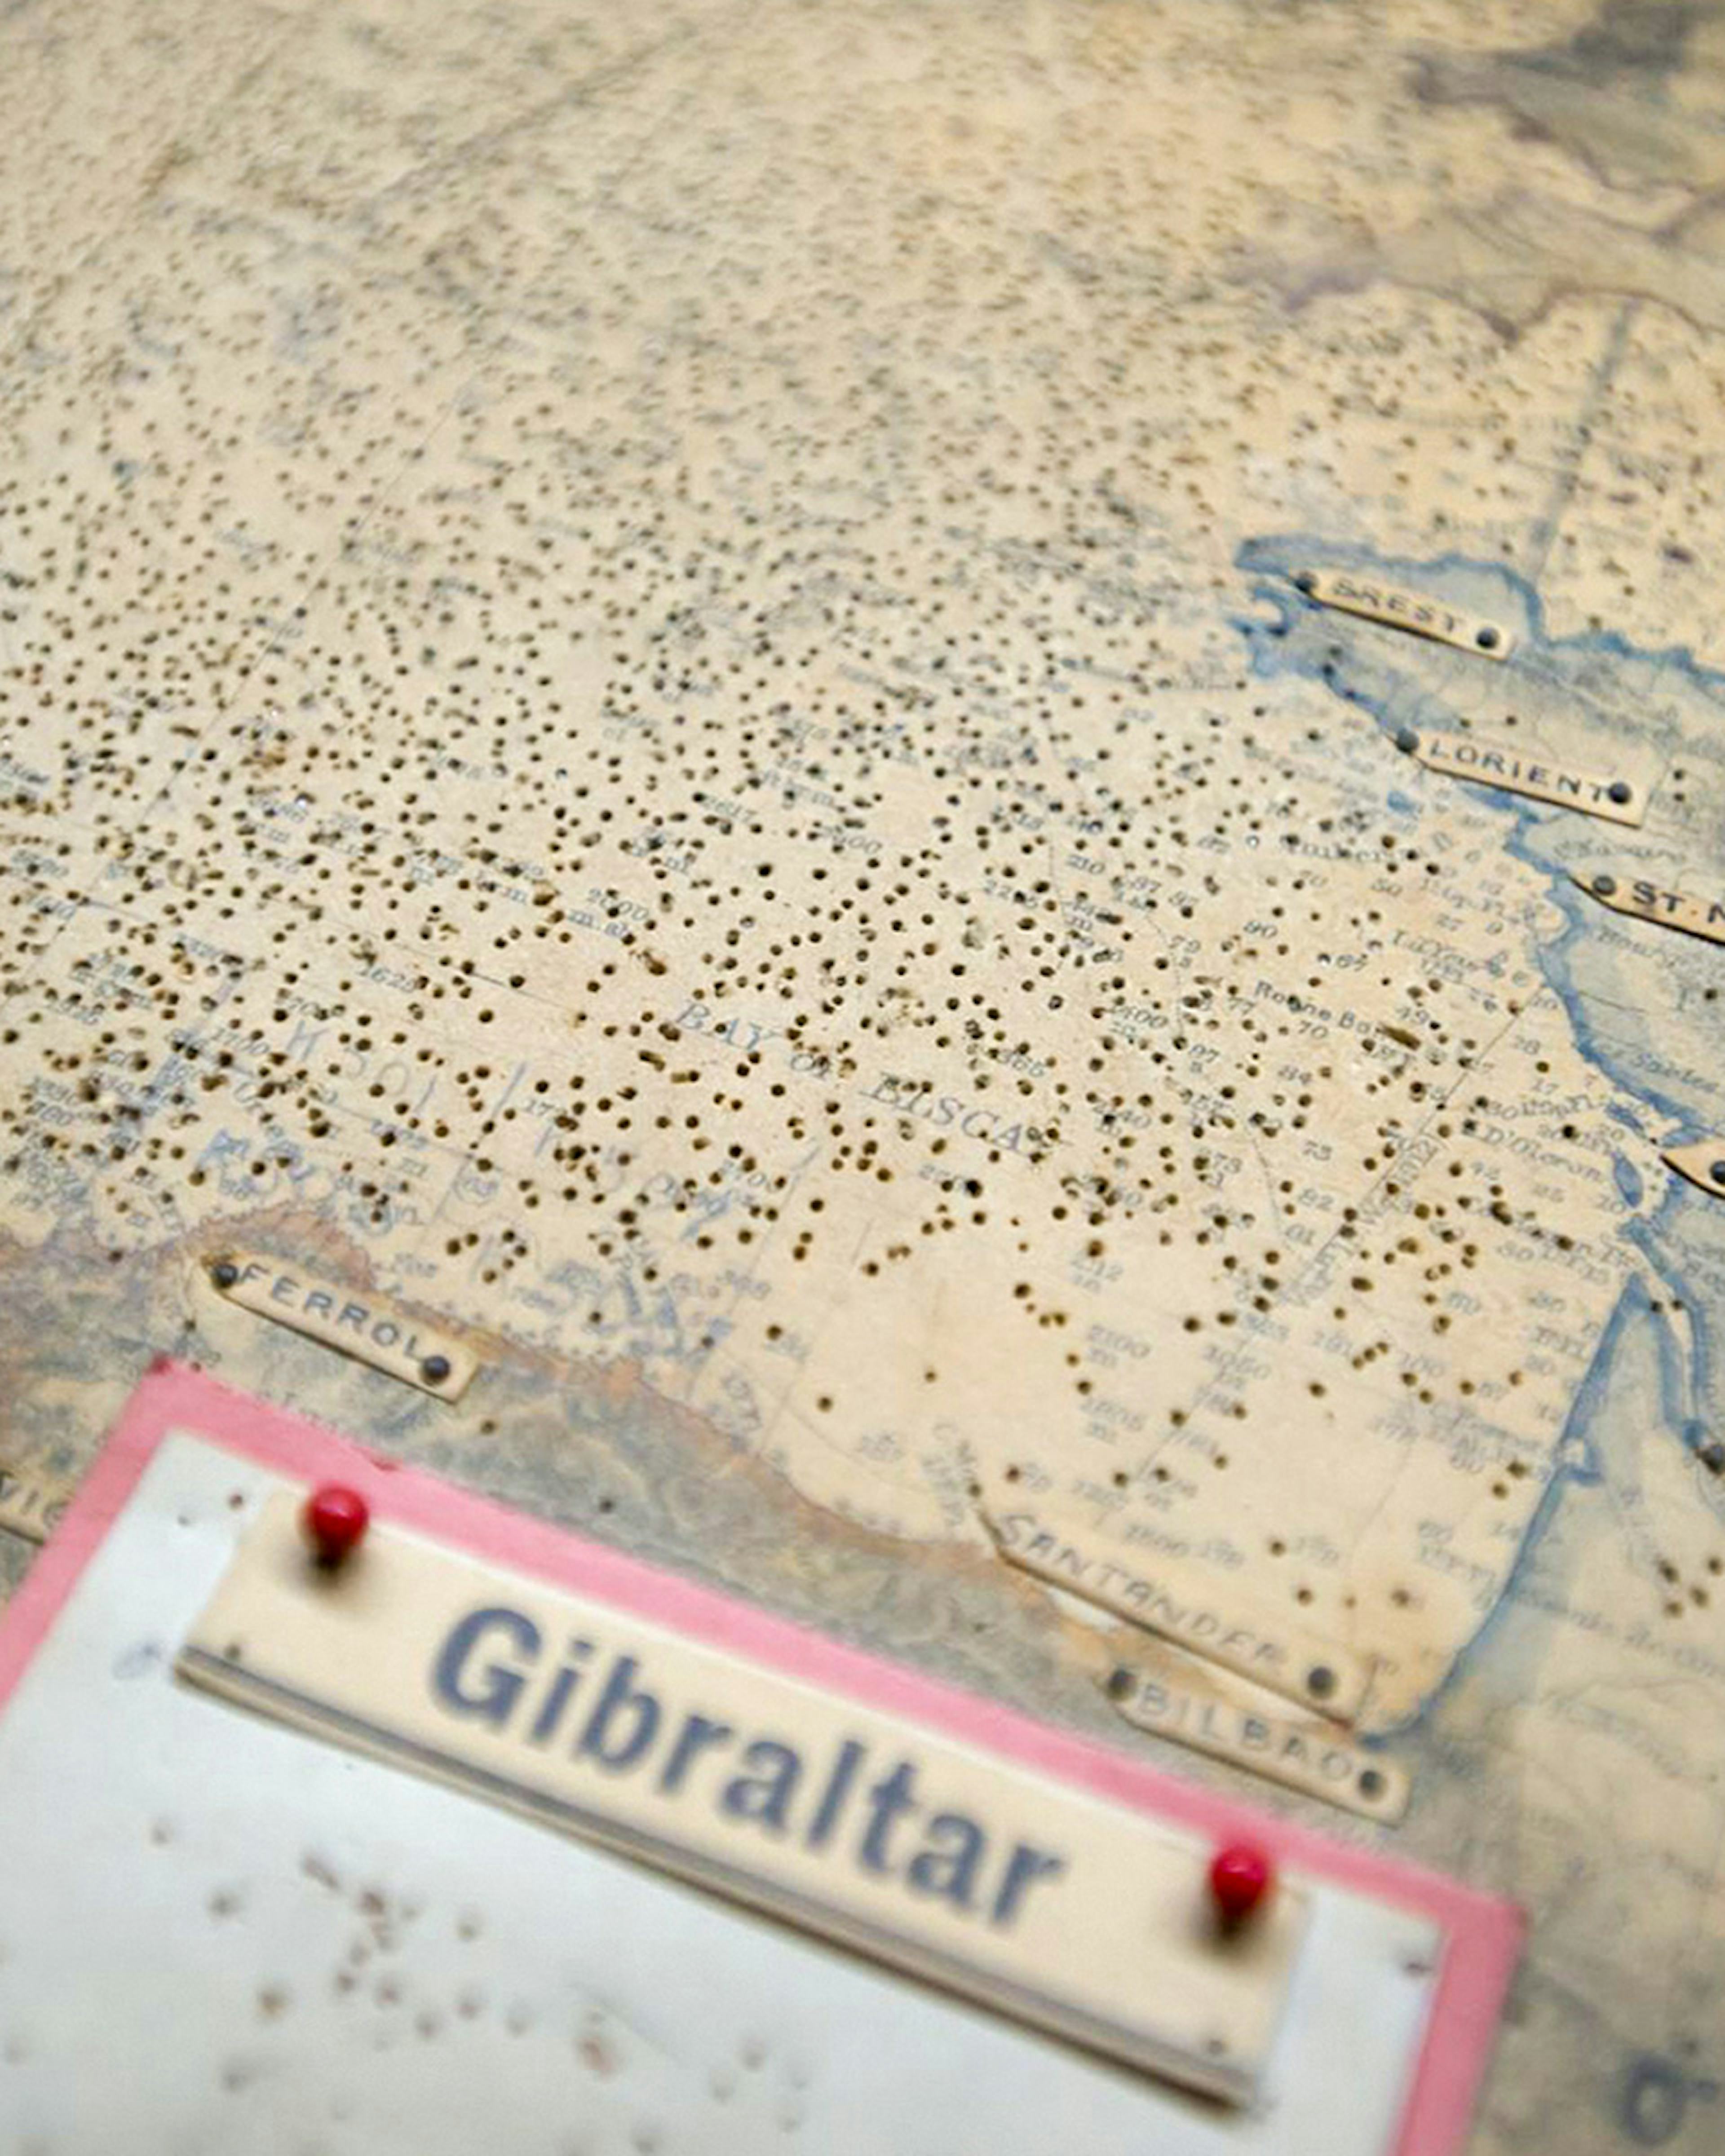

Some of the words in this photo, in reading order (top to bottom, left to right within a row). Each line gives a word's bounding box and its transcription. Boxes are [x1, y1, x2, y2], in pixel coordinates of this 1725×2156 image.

[1332, 581, 1461, 633] BREST
[1430, 739, 1614, 803] LORIENT
[1632, 881, 1685, 912] ST
[243, 1263, 423, 1359] FERROL
[995, 1512, 1288, 1665] SANTANDER
[432, 1605, 1067, 1927] Gibraltar
[1138, 1683, 1356, 1779] BILBAO
